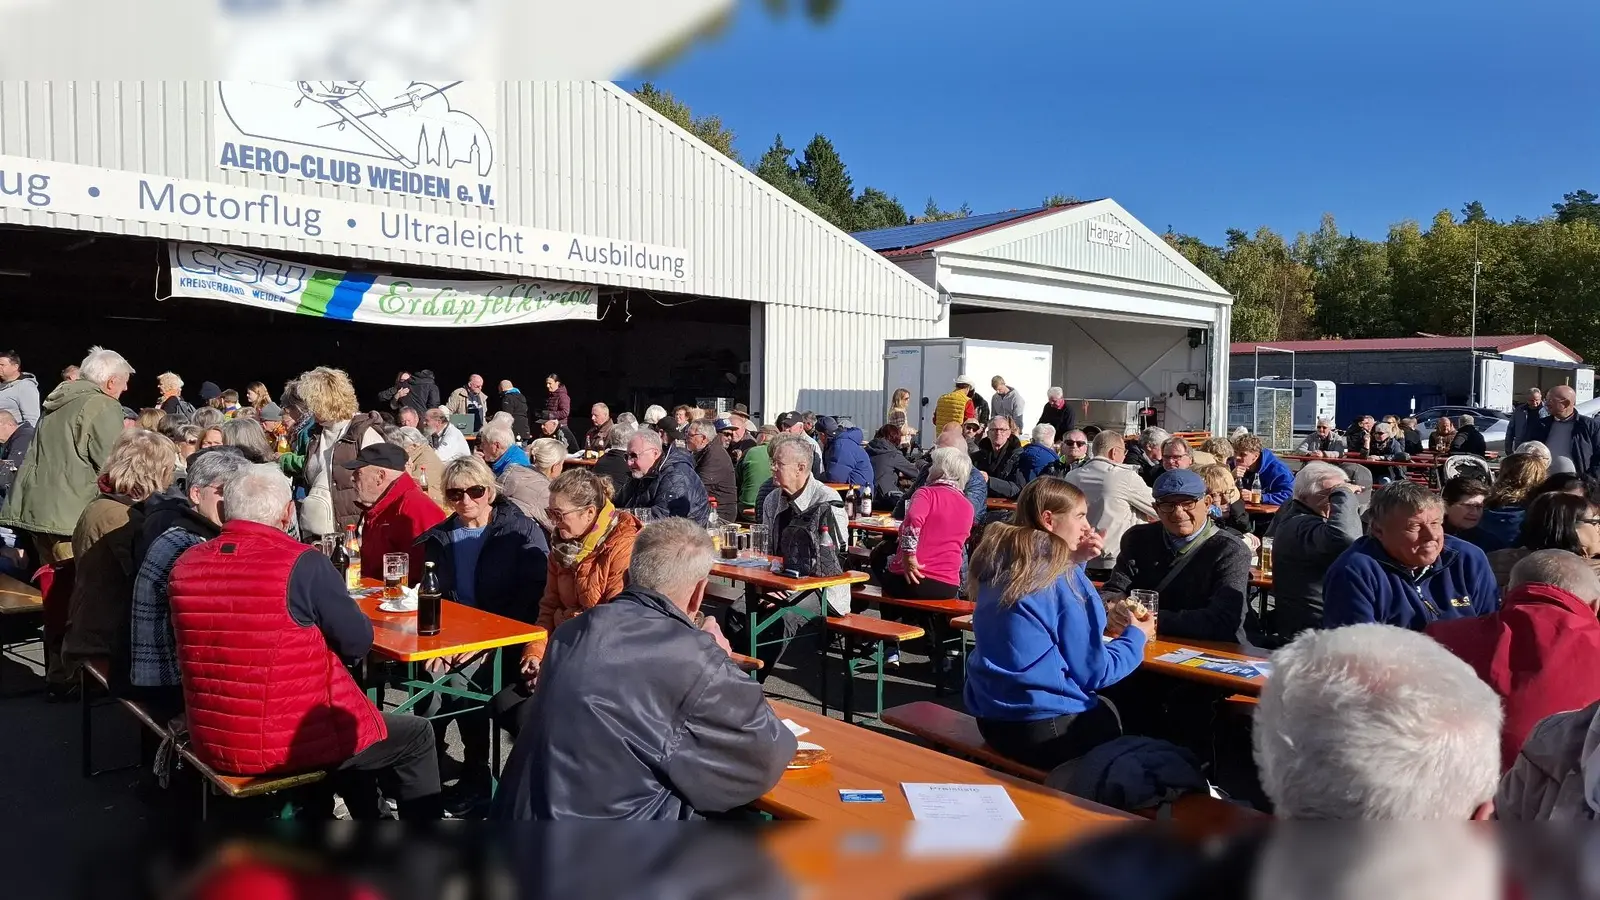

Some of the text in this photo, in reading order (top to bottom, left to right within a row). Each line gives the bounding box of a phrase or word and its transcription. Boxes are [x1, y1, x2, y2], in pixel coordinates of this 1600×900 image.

[220, 142, 362, 187] AERO-CLUB
[367, 165, 451, 200] WEIDEN
[138, 179, 322, 237] Motorflug
[380, 210, 524, 254] Ultraleicht
[567, 238, 685, 279] Ausbildung
[1090, 221, 1130, 246] Hangar 2
[177, 241, 306, 294] CSU
[179, 277, 286, 304] KREISVERBAND WEIDEN
